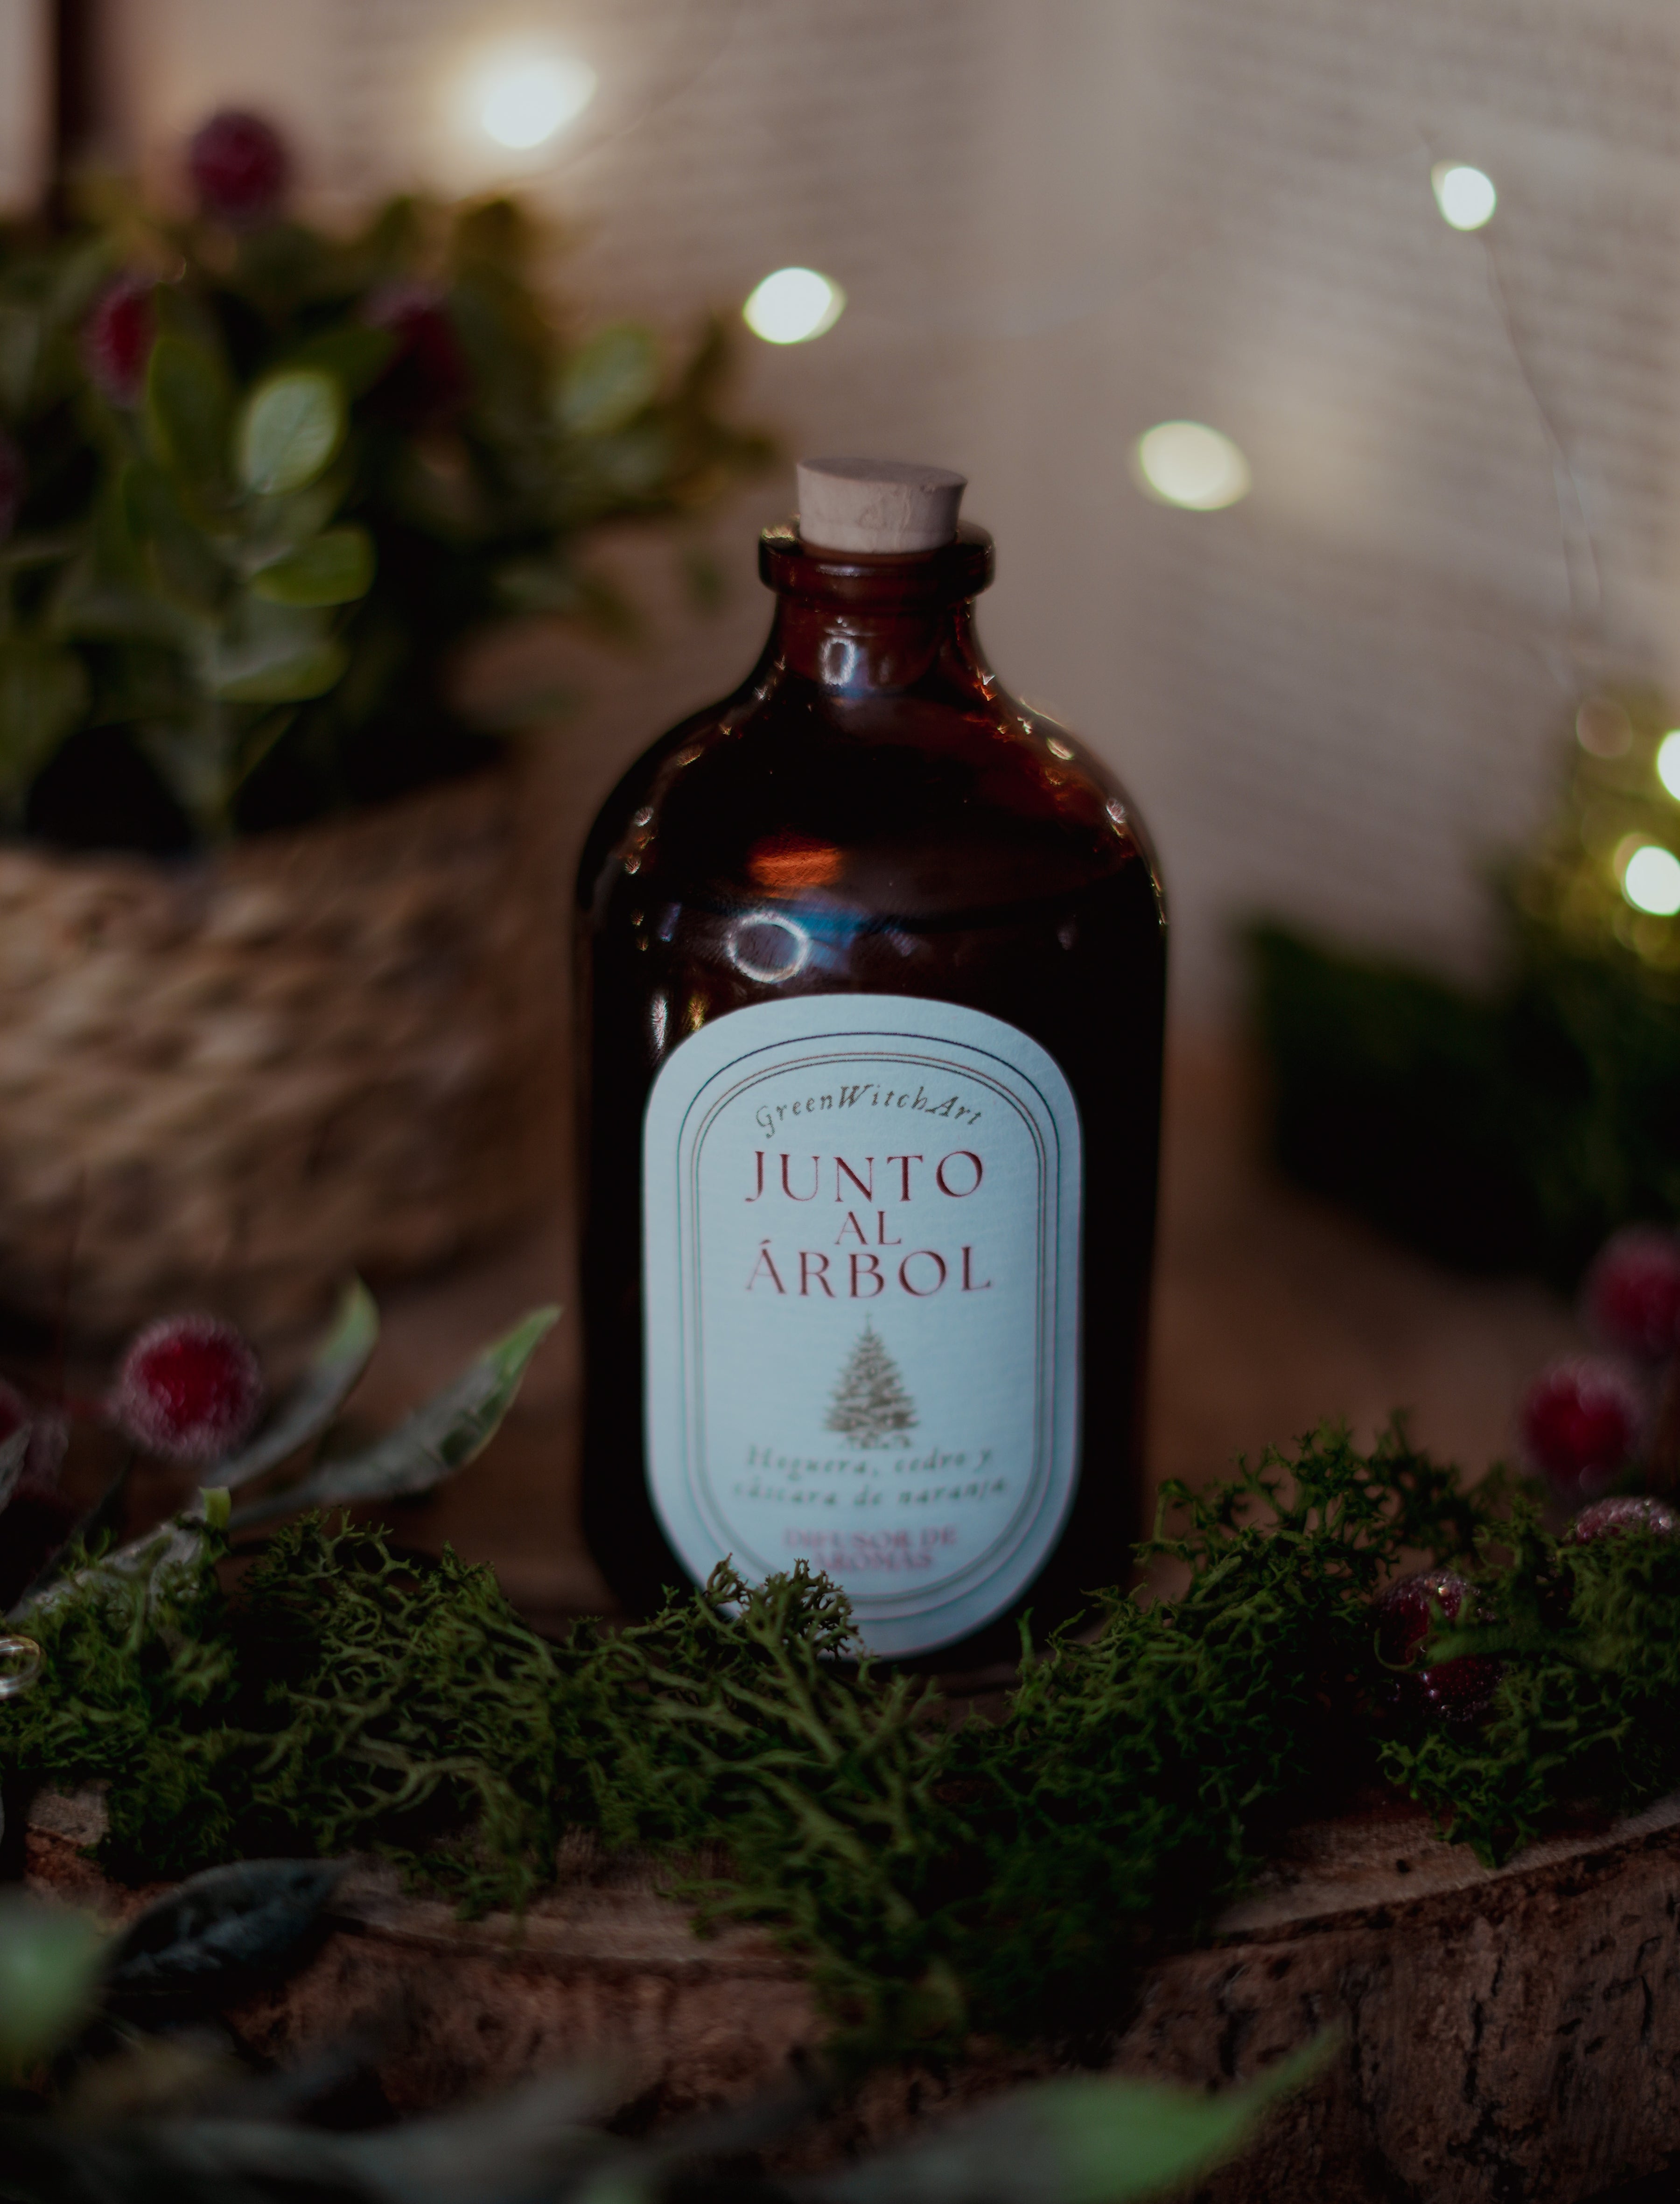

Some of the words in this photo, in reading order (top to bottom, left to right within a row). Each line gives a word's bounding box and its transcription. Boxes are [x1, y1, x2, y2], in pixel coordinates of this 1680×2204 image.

[755, 1083, 982, 1139] GreenWitchArt
[745, 1151, 983, 1202] JUNTO
[834, 1210, 902, 1245] AL
[745, 1239, 993, 1298] ÁRBOL
[894, 1447, 966, 1472] cedro
[853, 1485, 882, 1505] de
